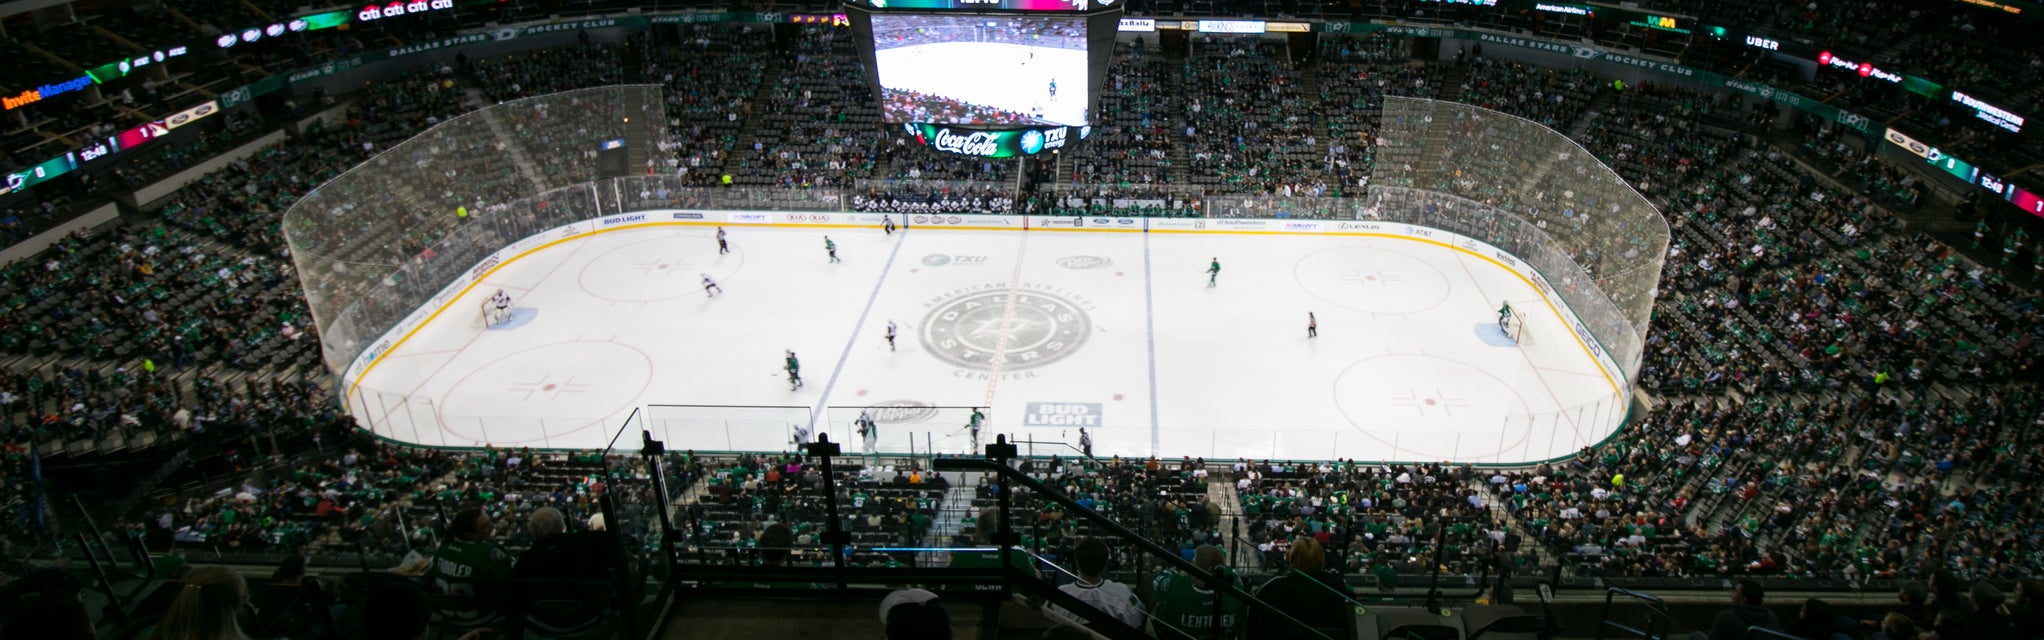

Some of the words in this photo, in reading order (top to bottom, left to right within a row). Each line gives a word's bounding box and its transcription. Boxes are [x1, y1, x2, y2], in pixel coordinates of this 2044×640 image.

[359, 8, 381, 21] citi
[384, 4, 405, 17] citi
[407, 0, 429, 13] citi
[1647, 15, 1676, 28] WM
[389, 41, 440, 57] DALLAS
[443, 33, 486, 47] STARS
[527, 21, 578, 34] HOCKEY
[583, 18, 616, 28] CLUB
[1746, 35, 1780, 51] UBER
[1481, 33, 1525, 47] DALLAS
[1529, 40, 1568, 53] STARS
[1606, 54, 1656, 69] HOCKEY
[1660, 64, 1693, 77] CLUB
[1952, 91, 1964, 102] UT
[1962, 95, 2025, 127] SOUTHWESTERN
[140, 128, 148, 138] 1
[1044, 126, 1068, 142] TXU
[934, 128, 1001, 156] Coca-Cola
[1044, 138, 1066, 150] energy
[604, 216, 621, 225] BUD
[622, 214, 646, 223] LIGHT
[1415, 228, 1432, 237] AT&T
[952, 255, 987, 263] TXU
[923, 281, 1007, 309] AMERICAN
[1022, 281, 1098, 312] AIRLINES
[942, 295, 1074, 324] DALLAS
[1575, 323, 1601, 357] GEICO
[939, 338, 1065, 365] STARS
[953, 369, 1037, 381] CENTER
[1040, 404, 1090, 415] BUD
[1027, 414, 1099, 426] LIGHT
